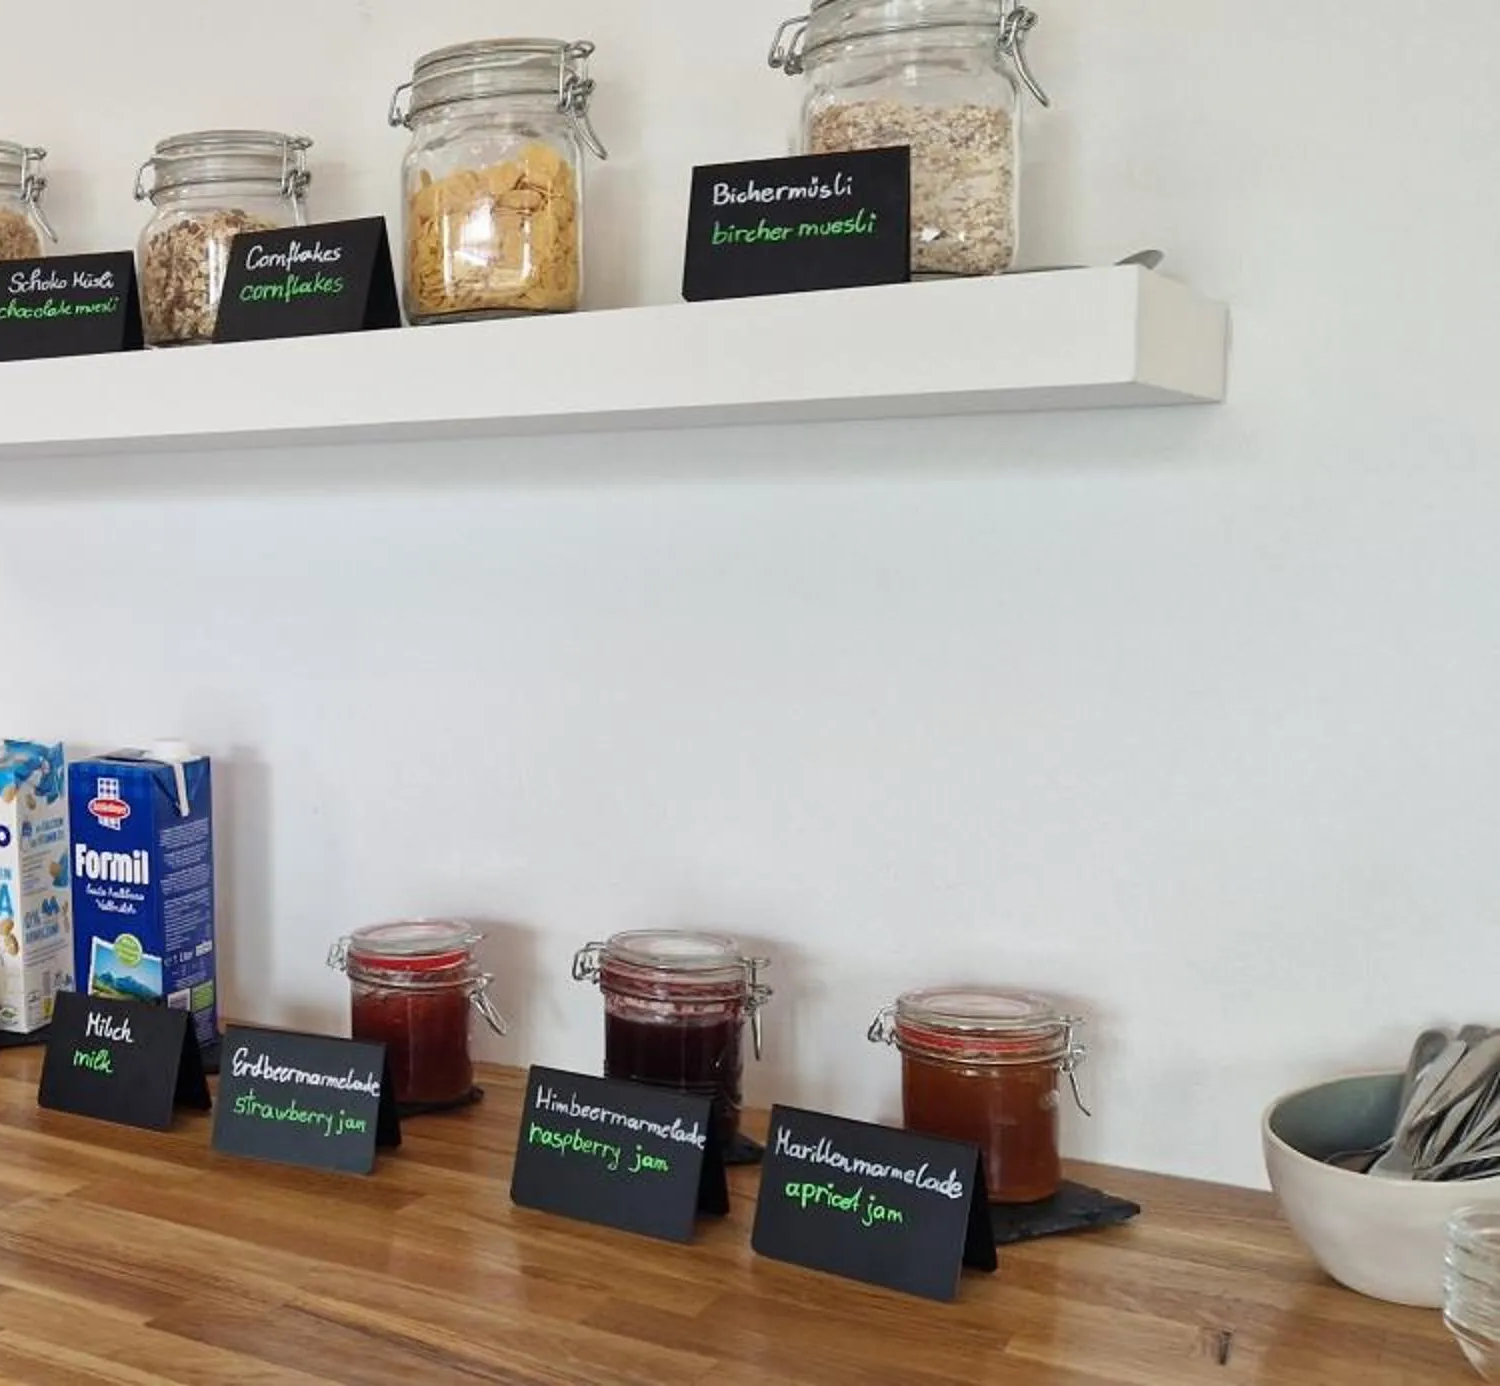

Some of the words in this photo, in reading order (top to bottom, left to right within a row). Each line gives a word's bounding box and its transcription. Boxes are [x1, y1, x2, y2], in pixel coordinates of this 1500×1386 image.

[713, 171, 853, 206] Bichermüsli
[711, 218, 793, 245] bircher
[799, 207, 877, 236] muesli
[245, 241, 341, 271] Cornflakes
[8, 267, 68, 293] Schoko
[239, 272, 344, 303] cornflakes
[75, 843, 149, 885] Formil
[85, 1011, 133, 1043] Milch
[73, 1049, 113, 1073] milk
[232, 1047, 380, 1097] Erdbeermarmelade
[234, 1088, 333, 1137] strawberry
[535, 1084, 707, 1150] Himbeermarmelade
[528, 1122, 621, 1170] raspberry
[627, 1144, 669, 1173] jam
[785, 1182, 862, 1212] apricot
[862, 1195, 903, 1227] jam
